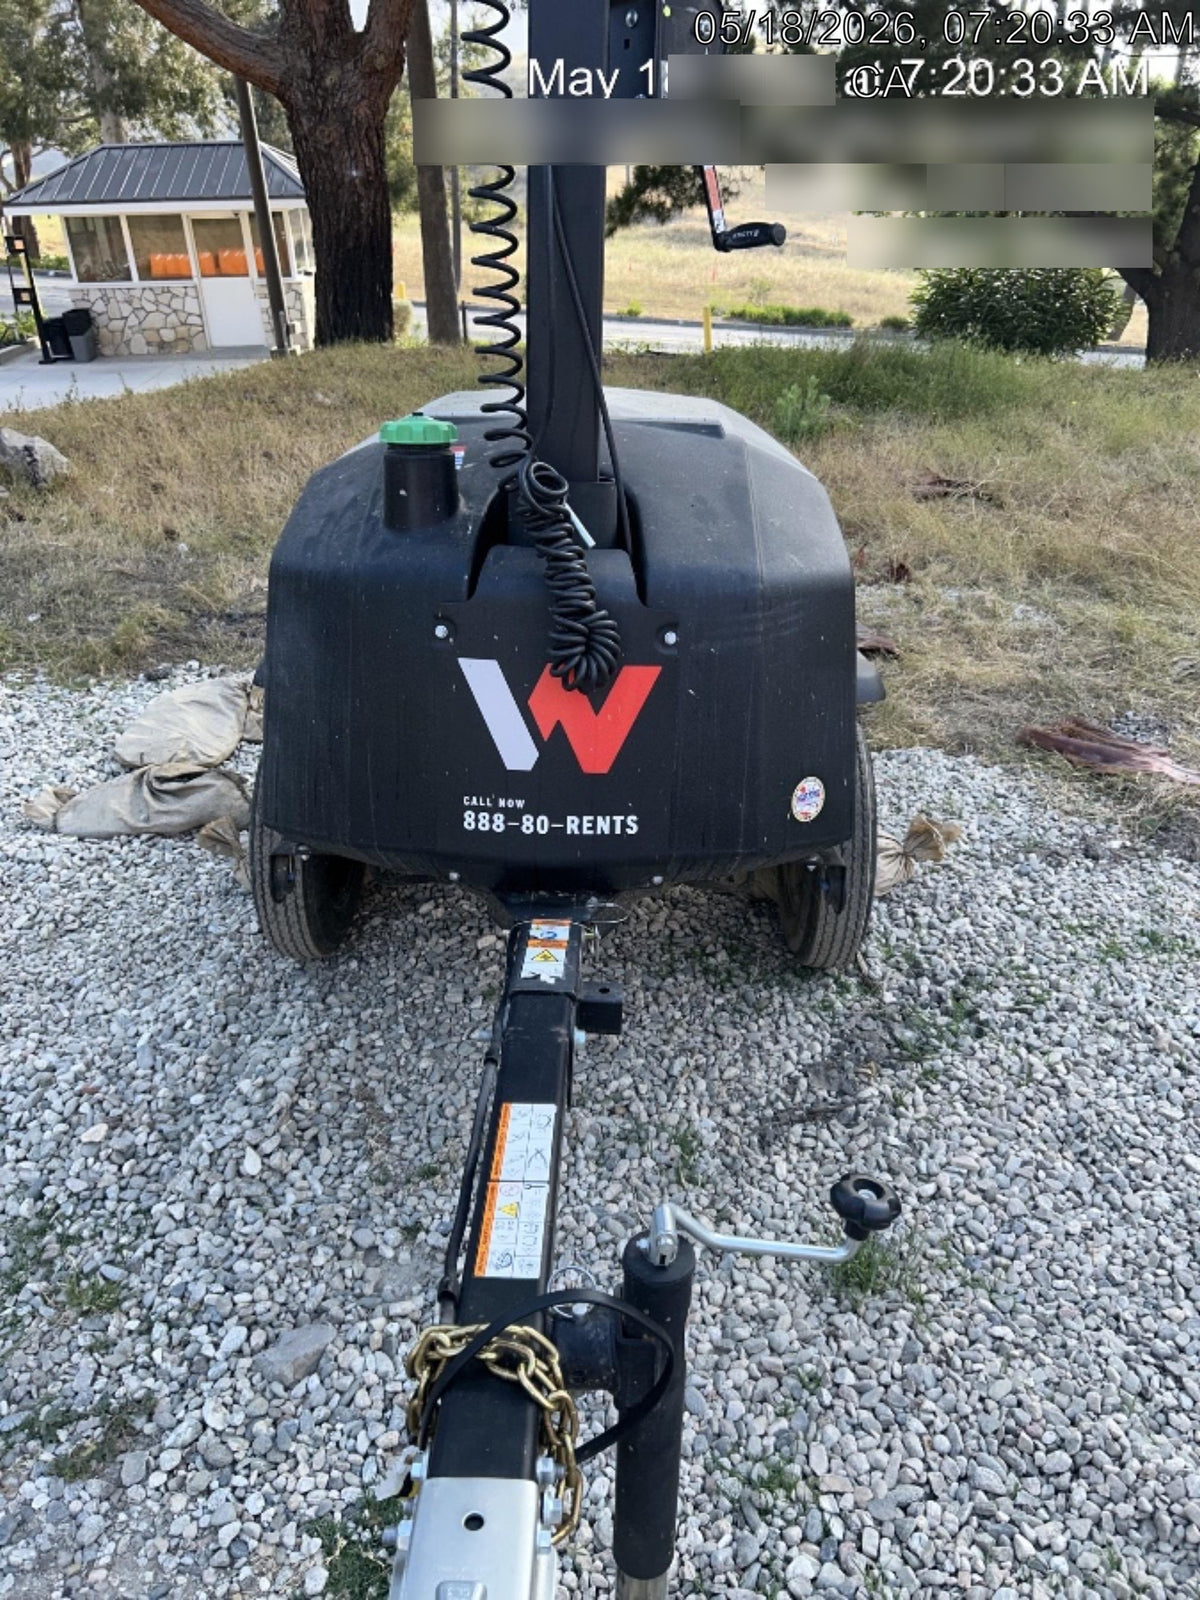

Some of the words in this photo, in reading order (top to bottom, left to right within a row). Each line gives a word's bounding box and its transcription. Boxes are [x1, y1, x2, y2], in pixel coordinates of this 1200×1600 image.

[463, 796, 493, 807] CALL
[498, 798, 526, 810] NOW
[463, 810, 639, 835] 888-80-RENTS
